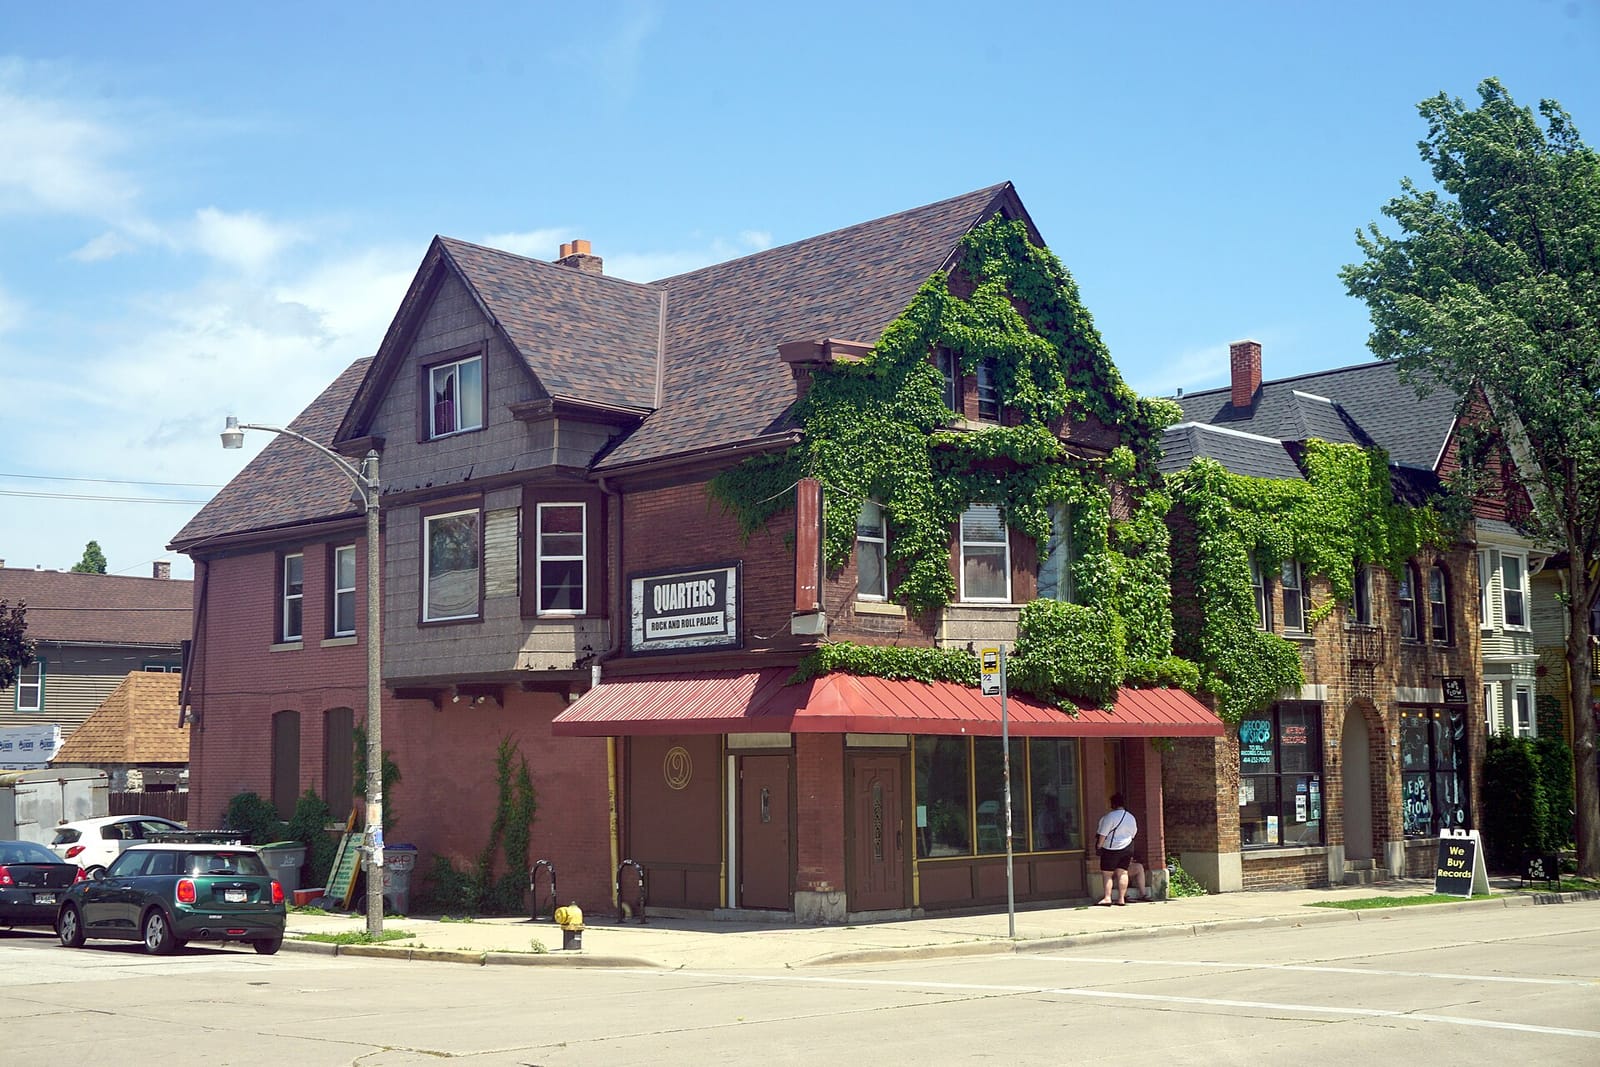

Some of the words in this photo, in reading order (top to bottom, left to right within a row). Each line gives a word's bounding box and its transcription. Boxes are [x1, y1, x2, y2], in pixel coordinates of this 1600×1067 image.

[653, 578, 716, 614] QUARTERS
[651, 620, 667, 631] ROCK
[668, 619, 680, 629] AND
[681, 617, 695, 628] ROLL
[696, 615, 719, 627] PALACE
[1243, 720, 1270, 731] RECORD
[1249, 730, 1270, 743] SHOP
[1408, 776, 1425, 795] EBB
[1449, 846, 1465, 856] We
[1447, 858, 1465, 869] Buy
[1437, 868, 1472, 878] Records
